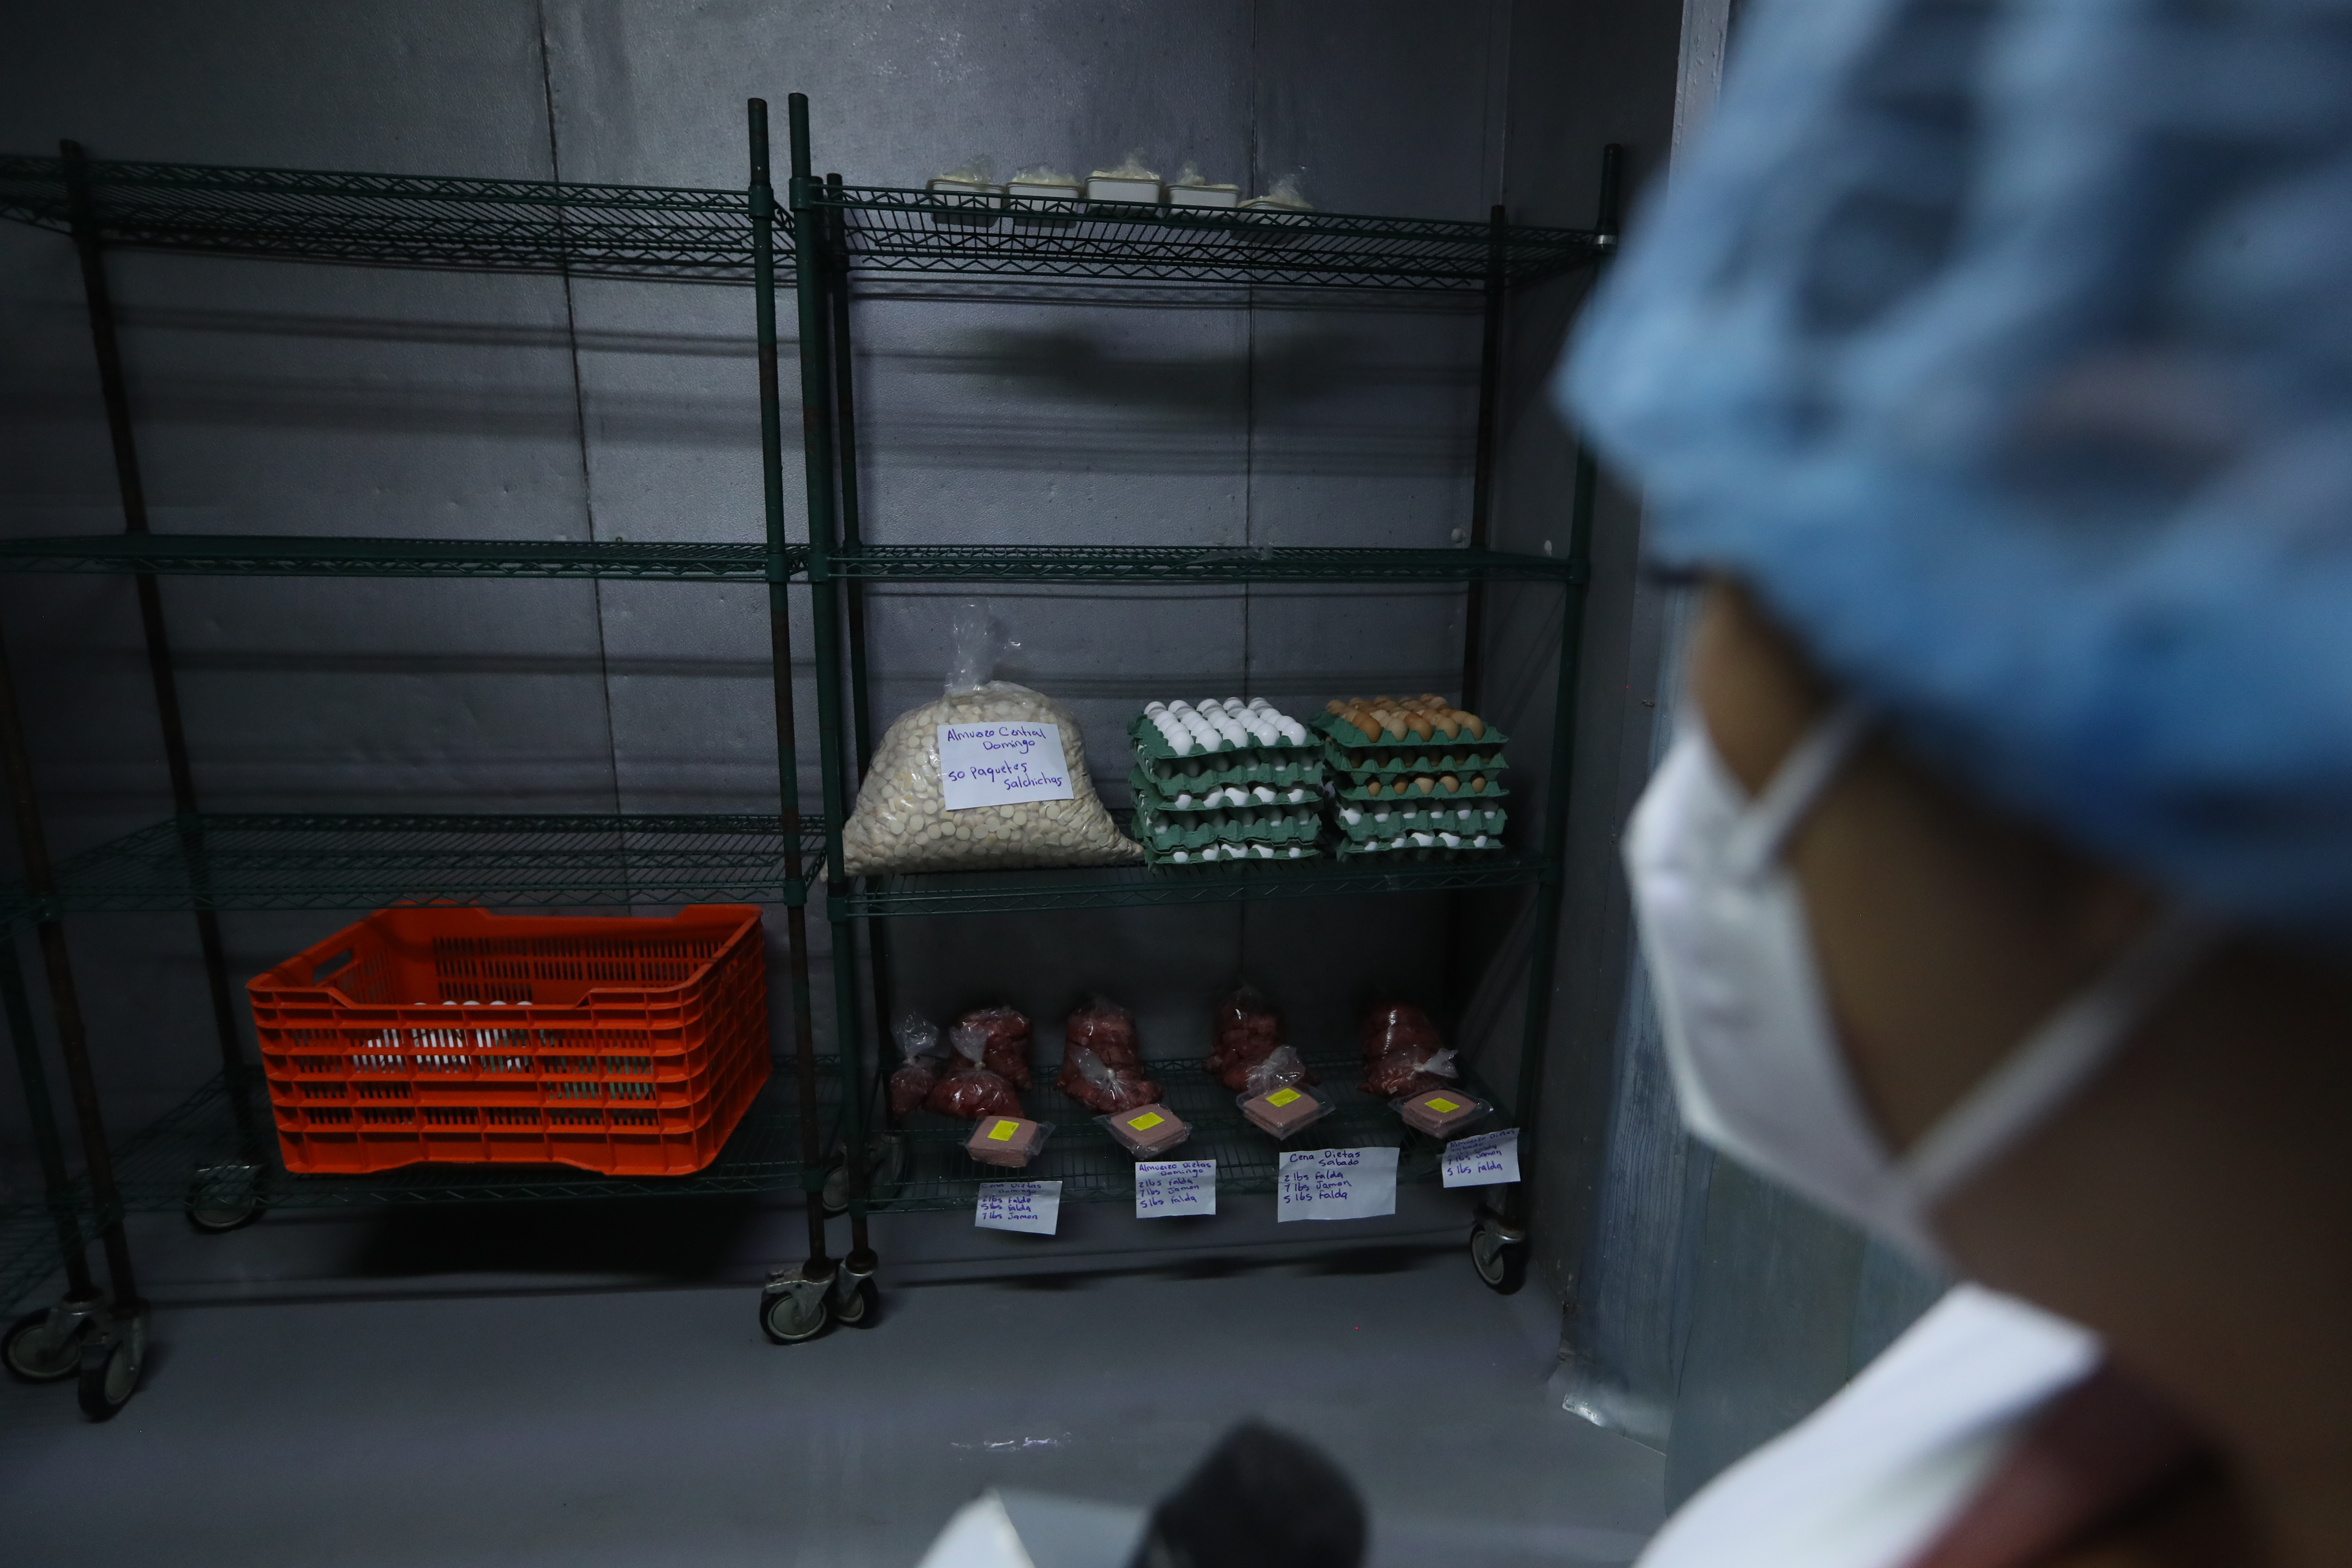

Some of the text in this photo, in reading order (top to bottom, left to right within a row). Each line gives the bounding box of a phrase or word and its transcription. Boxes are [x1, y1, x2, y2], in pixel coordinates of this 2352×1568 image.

[999, 726, 1046, 738] Central
[983, 740, 1035, 753] Domingo
[1289, 1150, 1360, 1162] Cena Dietas
[1161, 1169, 1203, 1178] Domingo
[1447, 1168, 1453, 1176] 5
[1457, 1163, 1471, 1174] lbs
[1293, 1172, 1309, 1181] lbs
[1167, 1185, 1199, 1194] Jamon
[1295, 1182, 1309, 1191] lbs
[1316, 1180, 1352, 1189] Jamon
[1283, 1195, 1290, 1204] 5
[1295, 1192, 1312, 1201] lbs
[989, 1210, 1002, 1219] lbs
